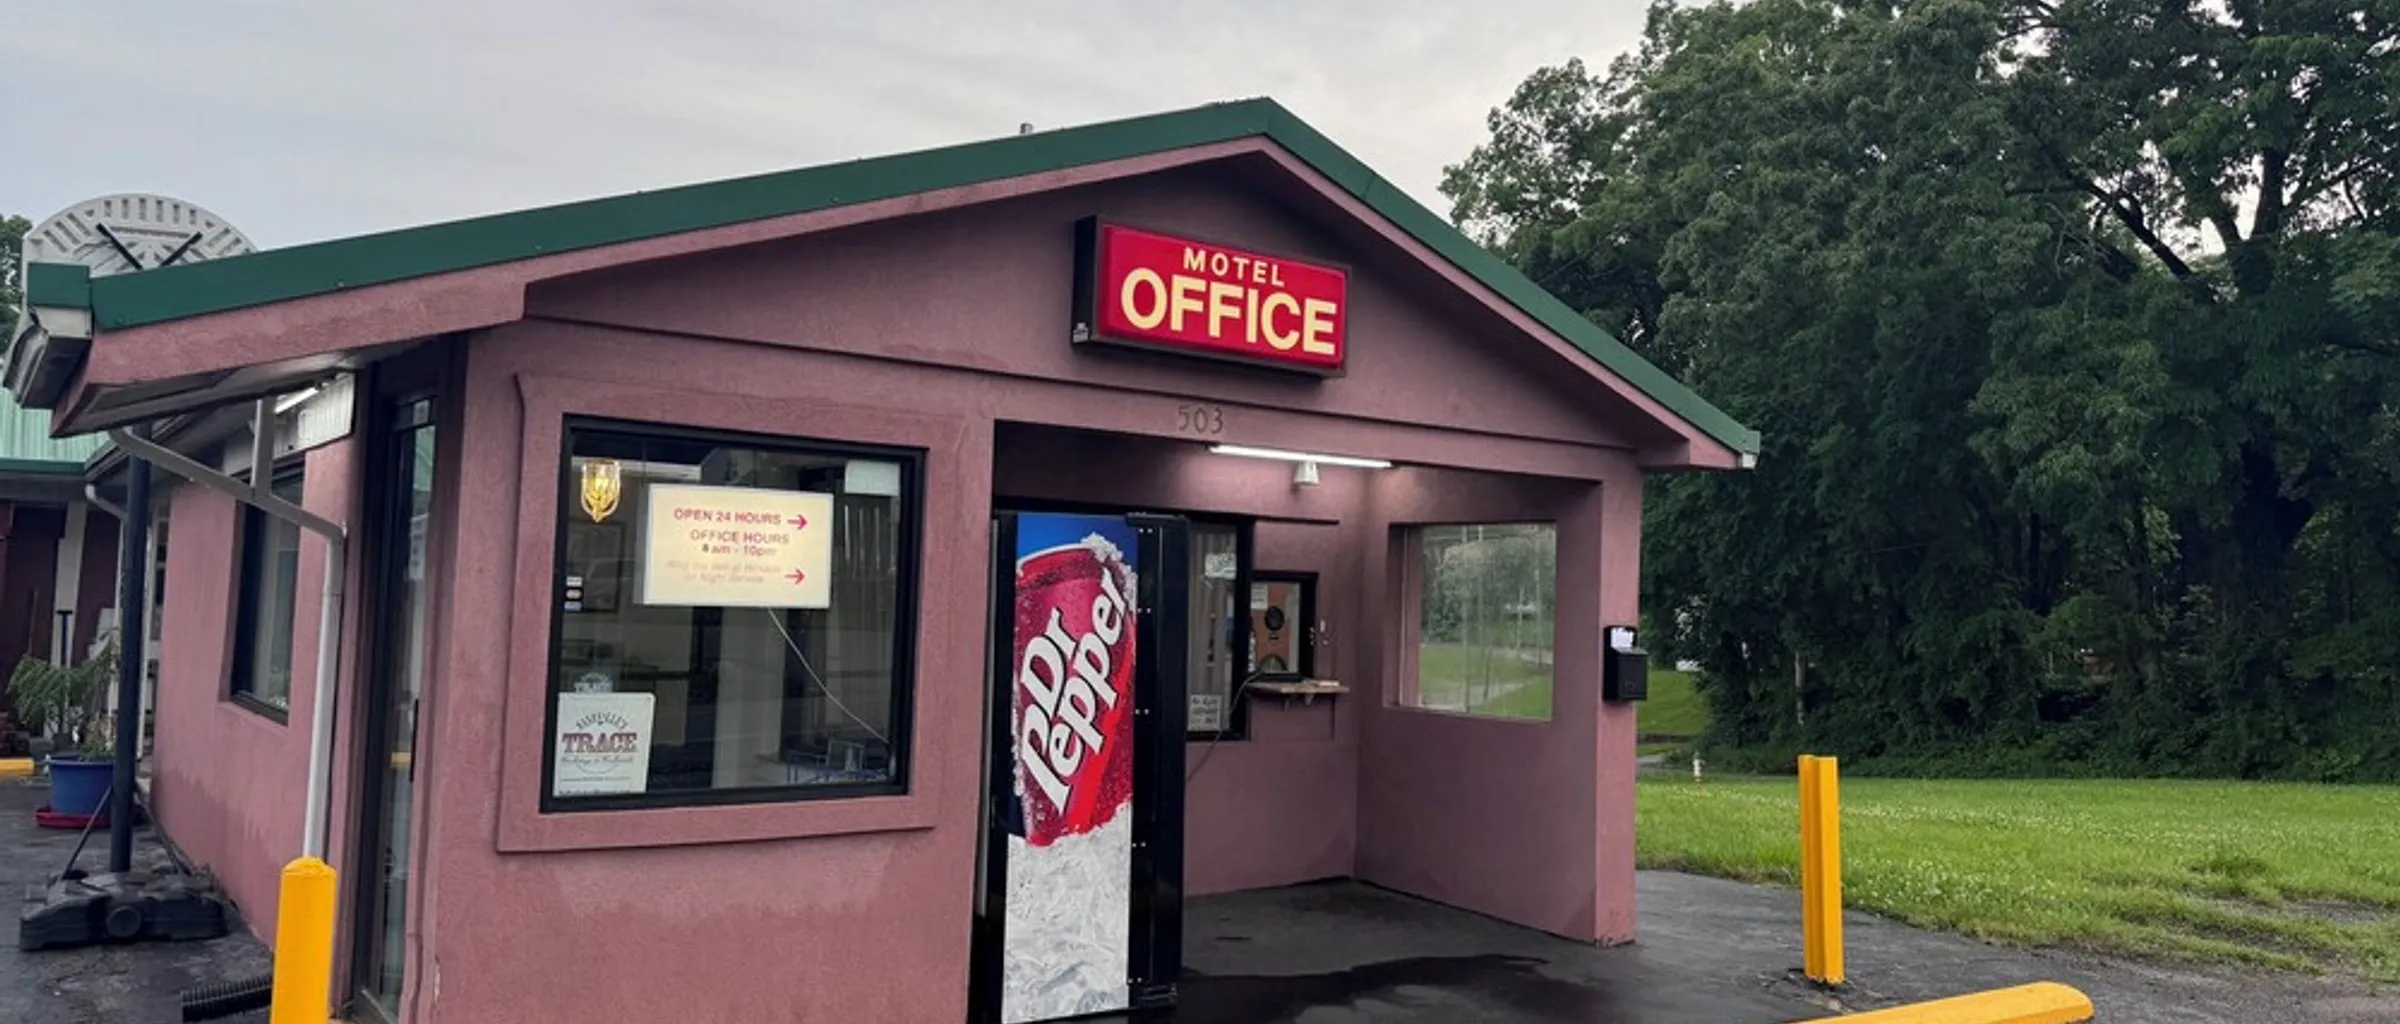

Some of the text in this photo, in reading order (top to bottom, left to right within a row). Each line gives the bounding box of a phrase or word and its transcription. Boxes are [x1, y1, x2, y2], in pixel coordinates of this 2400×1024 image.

[1183, 246, 1286, 287] MOTEL
[1120, 267, 1338, 355] OFFICE
[1177, 404, 1224, 435] 503
[673, 507, 782, 525] OPEN 24 HOURS
[689, 529, 790, 545] OFFICE HOURS
[710, 545, 731, 554] am
[743, 545, 777, 557] 10pm
[1020, 606, 1077, 720] Dr
[1021, 566, 1127, 817] Pepper
[561, 732, 639, 754] TRACE
